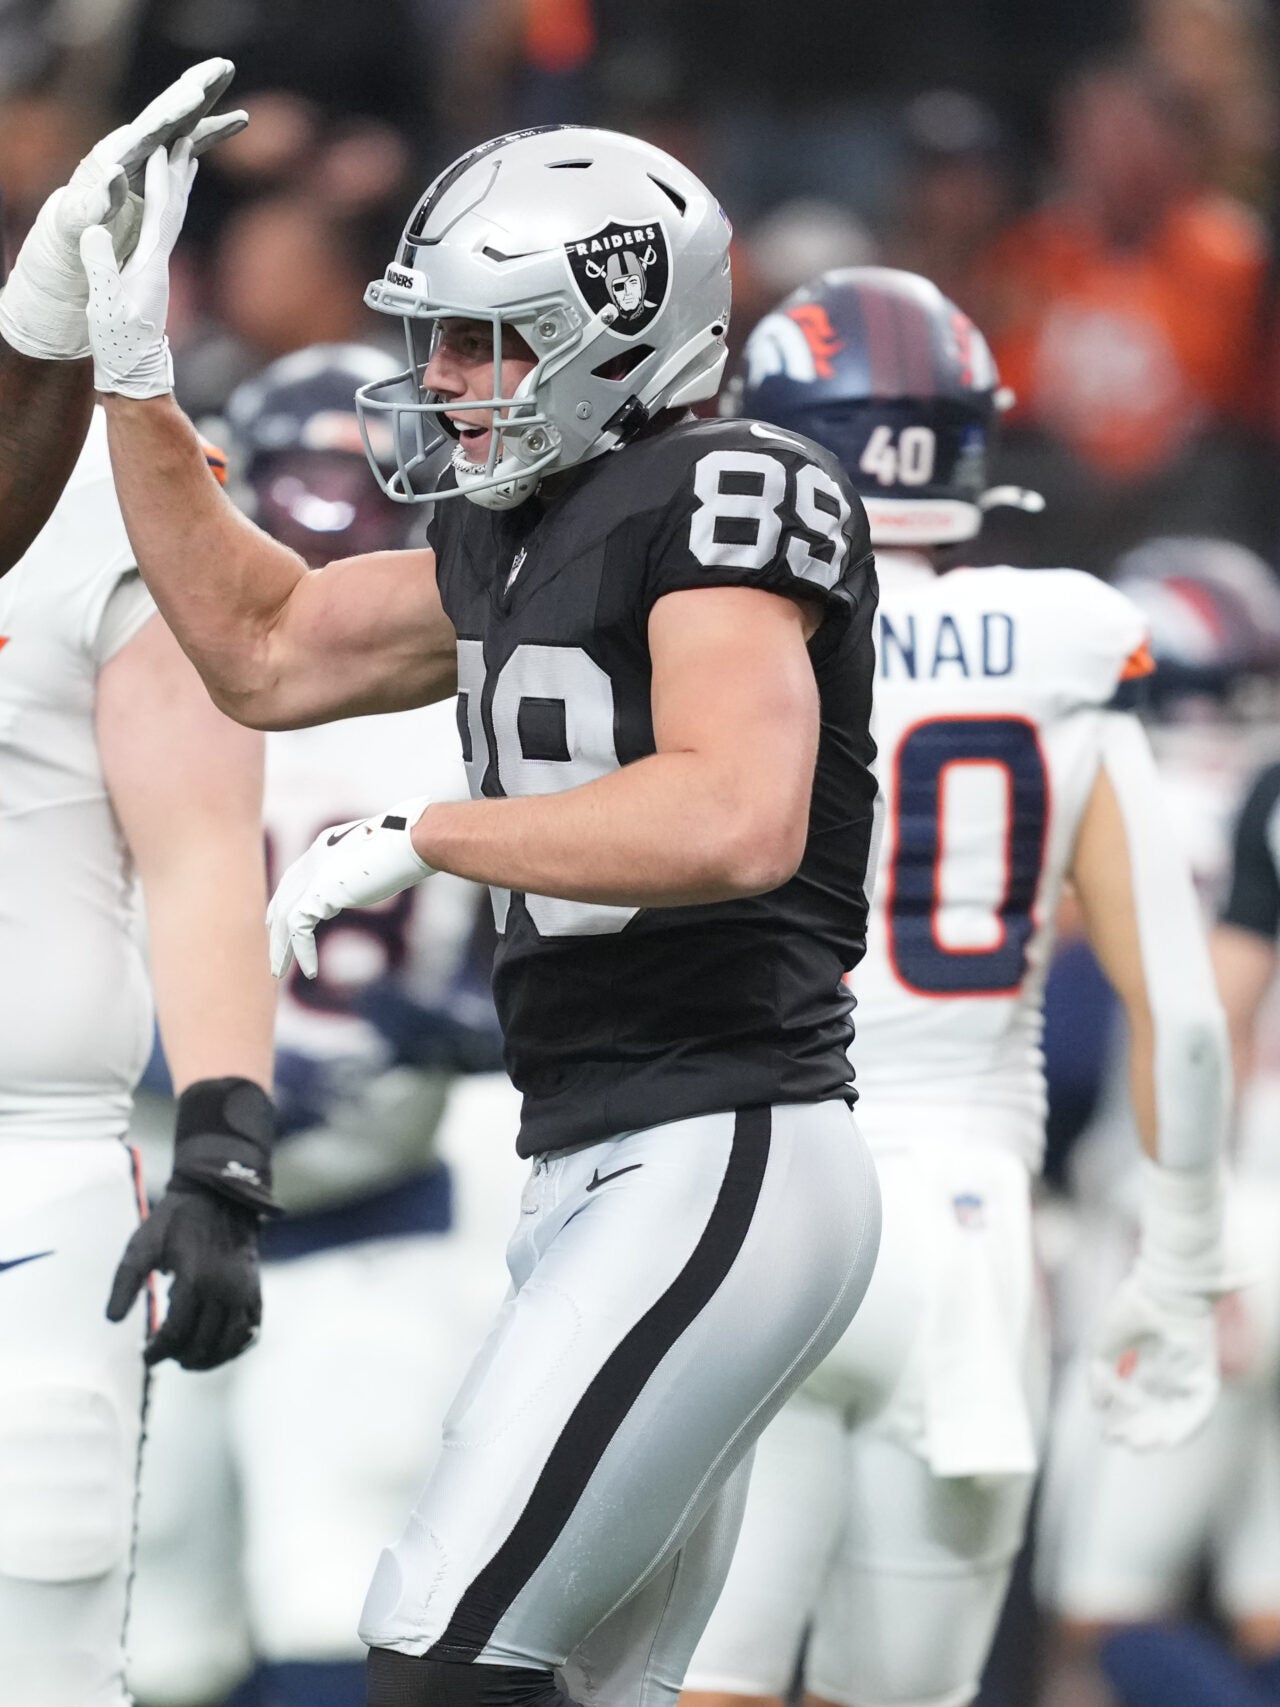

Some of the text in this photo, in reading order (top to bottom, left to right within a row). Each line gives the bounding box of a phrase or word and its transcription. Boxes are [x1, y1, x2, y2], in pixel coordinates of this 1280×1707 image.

[575, 226, 656, 256] RAIDERS
[860, 424, 936, 487] 40
[688, 450, 850, 591] 89
